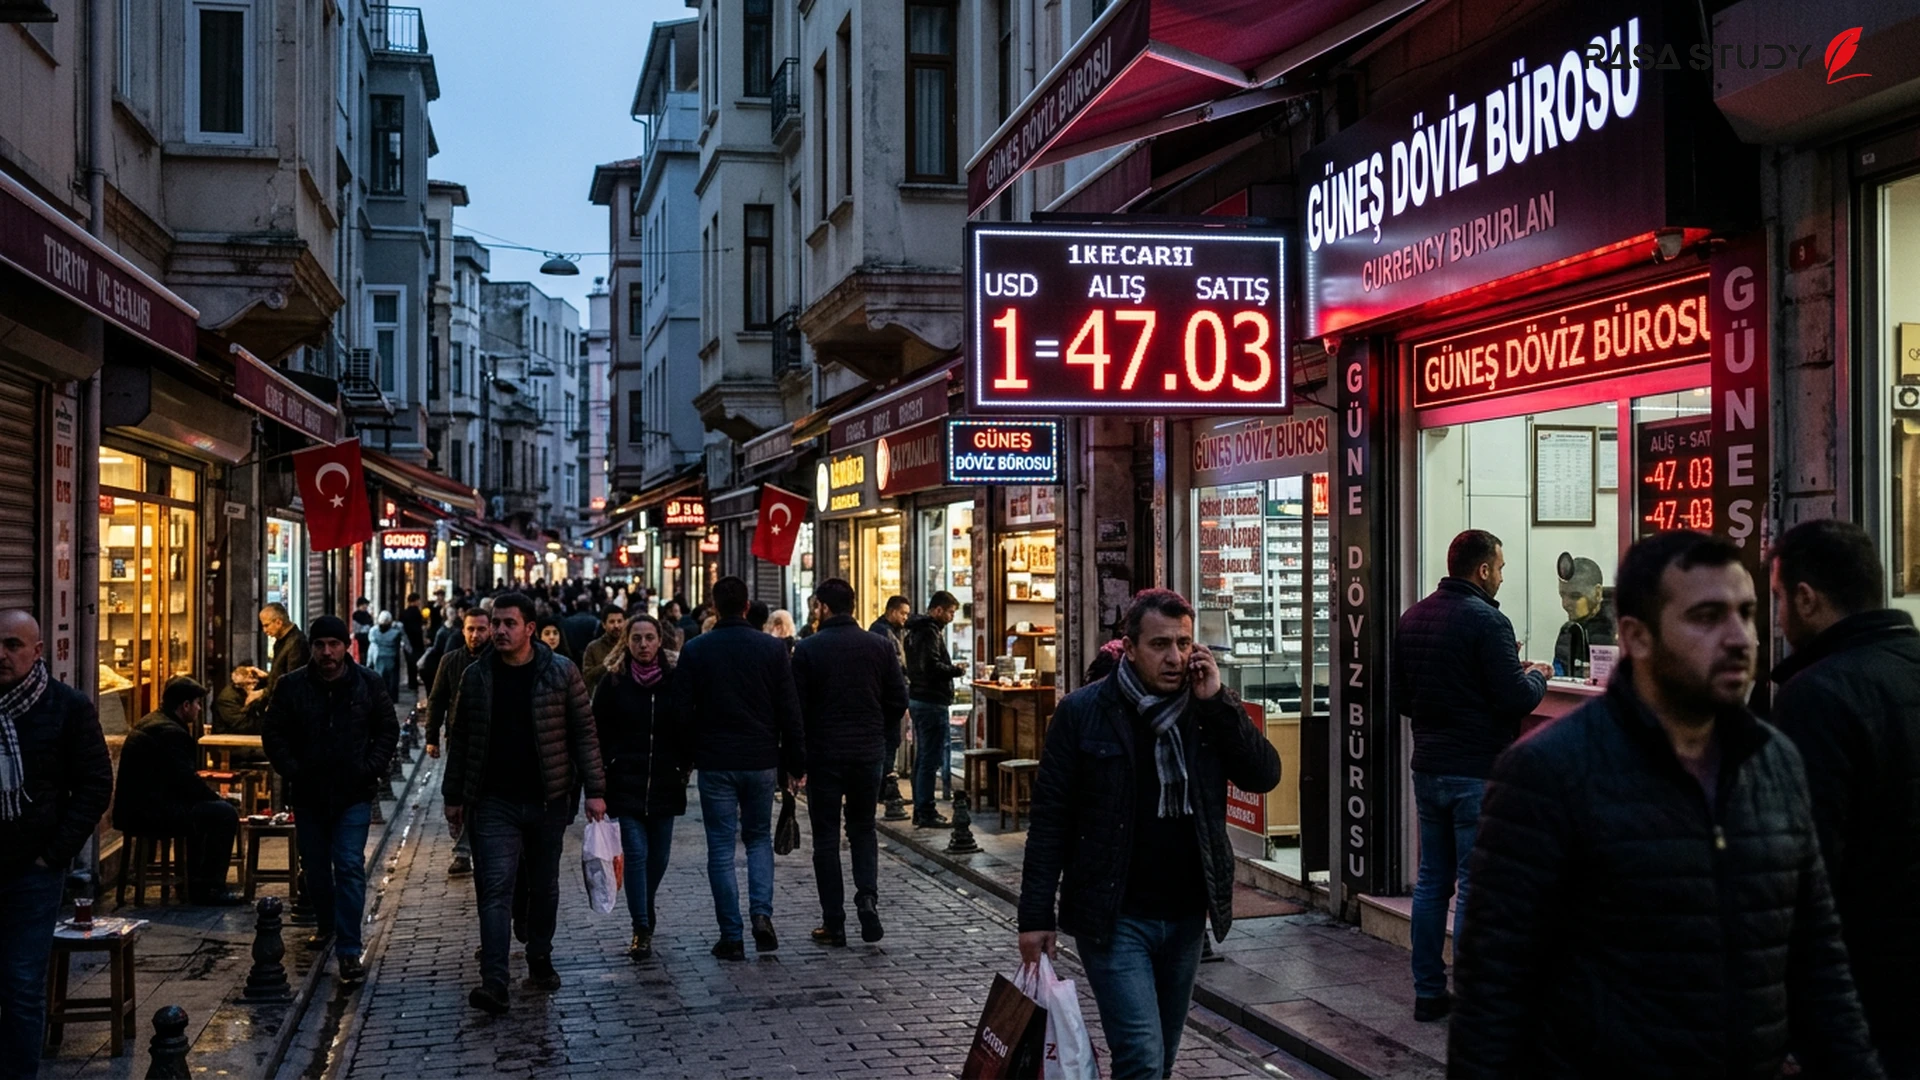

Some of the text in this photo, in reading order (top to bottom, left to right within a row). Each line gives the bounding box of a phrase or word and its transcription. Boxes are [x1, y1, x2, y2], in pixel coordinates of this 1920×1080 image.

[1307, 17, 1640, 252] GÜNEŞ DÖVİZ BÜROSU
[985, 273, 1270, 306] USD ALIŞ SATIŞ
[1362, 190, 1556, 293] CURRENCY BURURLAN
[1424, 342, 1500, 391] GÜNEŞ
[1506, 315, 1586, 379] DÖVİZ
[974, 428, 1032, 452] GÜNEŞ
[1723, 265, 1756, 548] GÜNEŞ
[1347, 703, 1366, 877] BÜROSU
